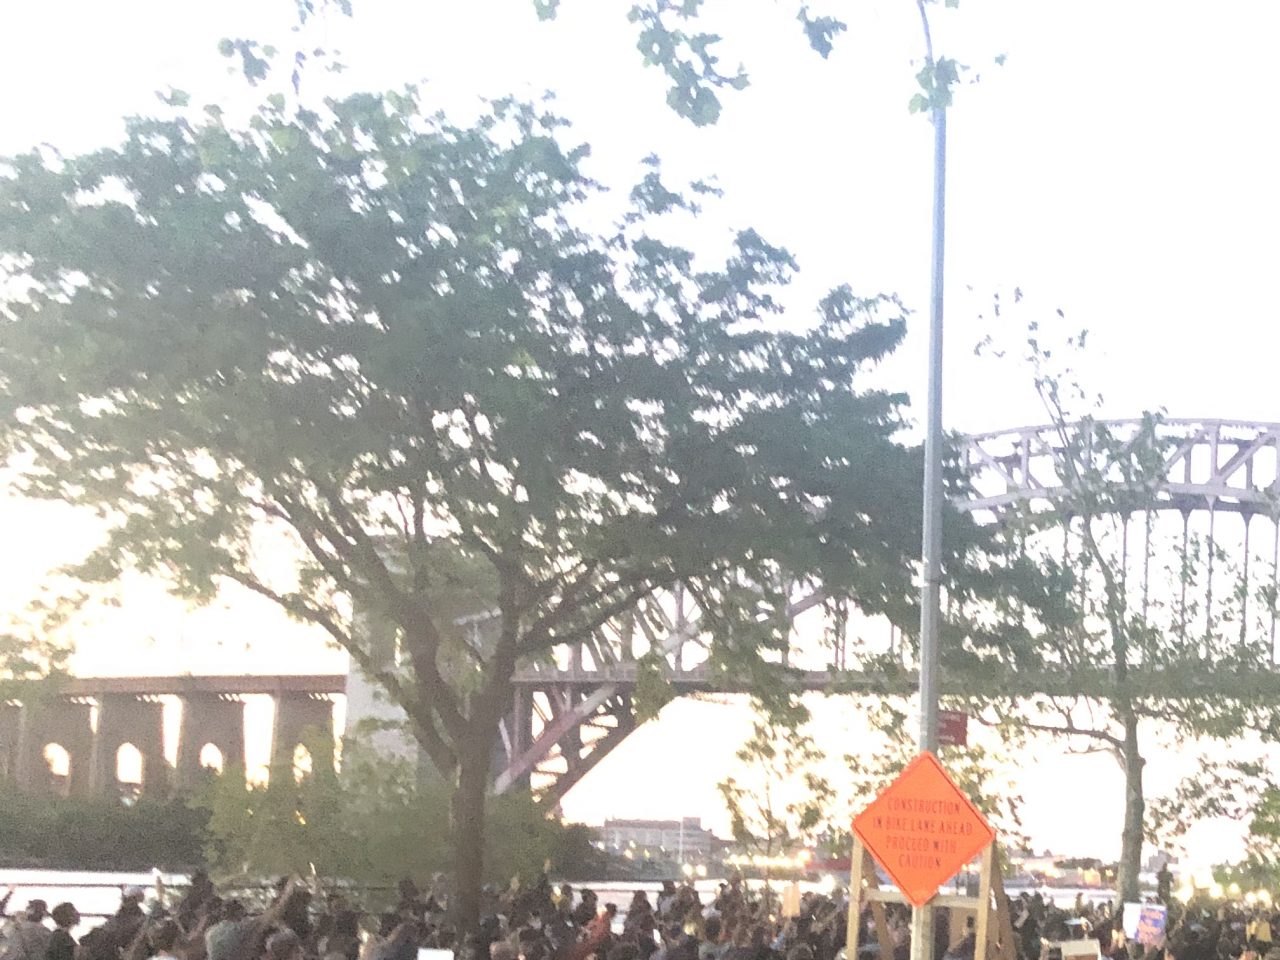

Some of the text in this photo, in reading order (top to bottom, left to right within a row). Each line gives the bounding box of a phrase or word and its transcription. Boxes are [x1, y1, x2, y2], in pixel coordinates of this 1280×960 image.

[887, 799, 960, 815] CONSTRUCTION
[873, 817, 973, 836] IN BIKE LANE AHEAD
[886, 836, 958, 853] PROCEED WITH
[898, 854, 941, 868] CAUTION
